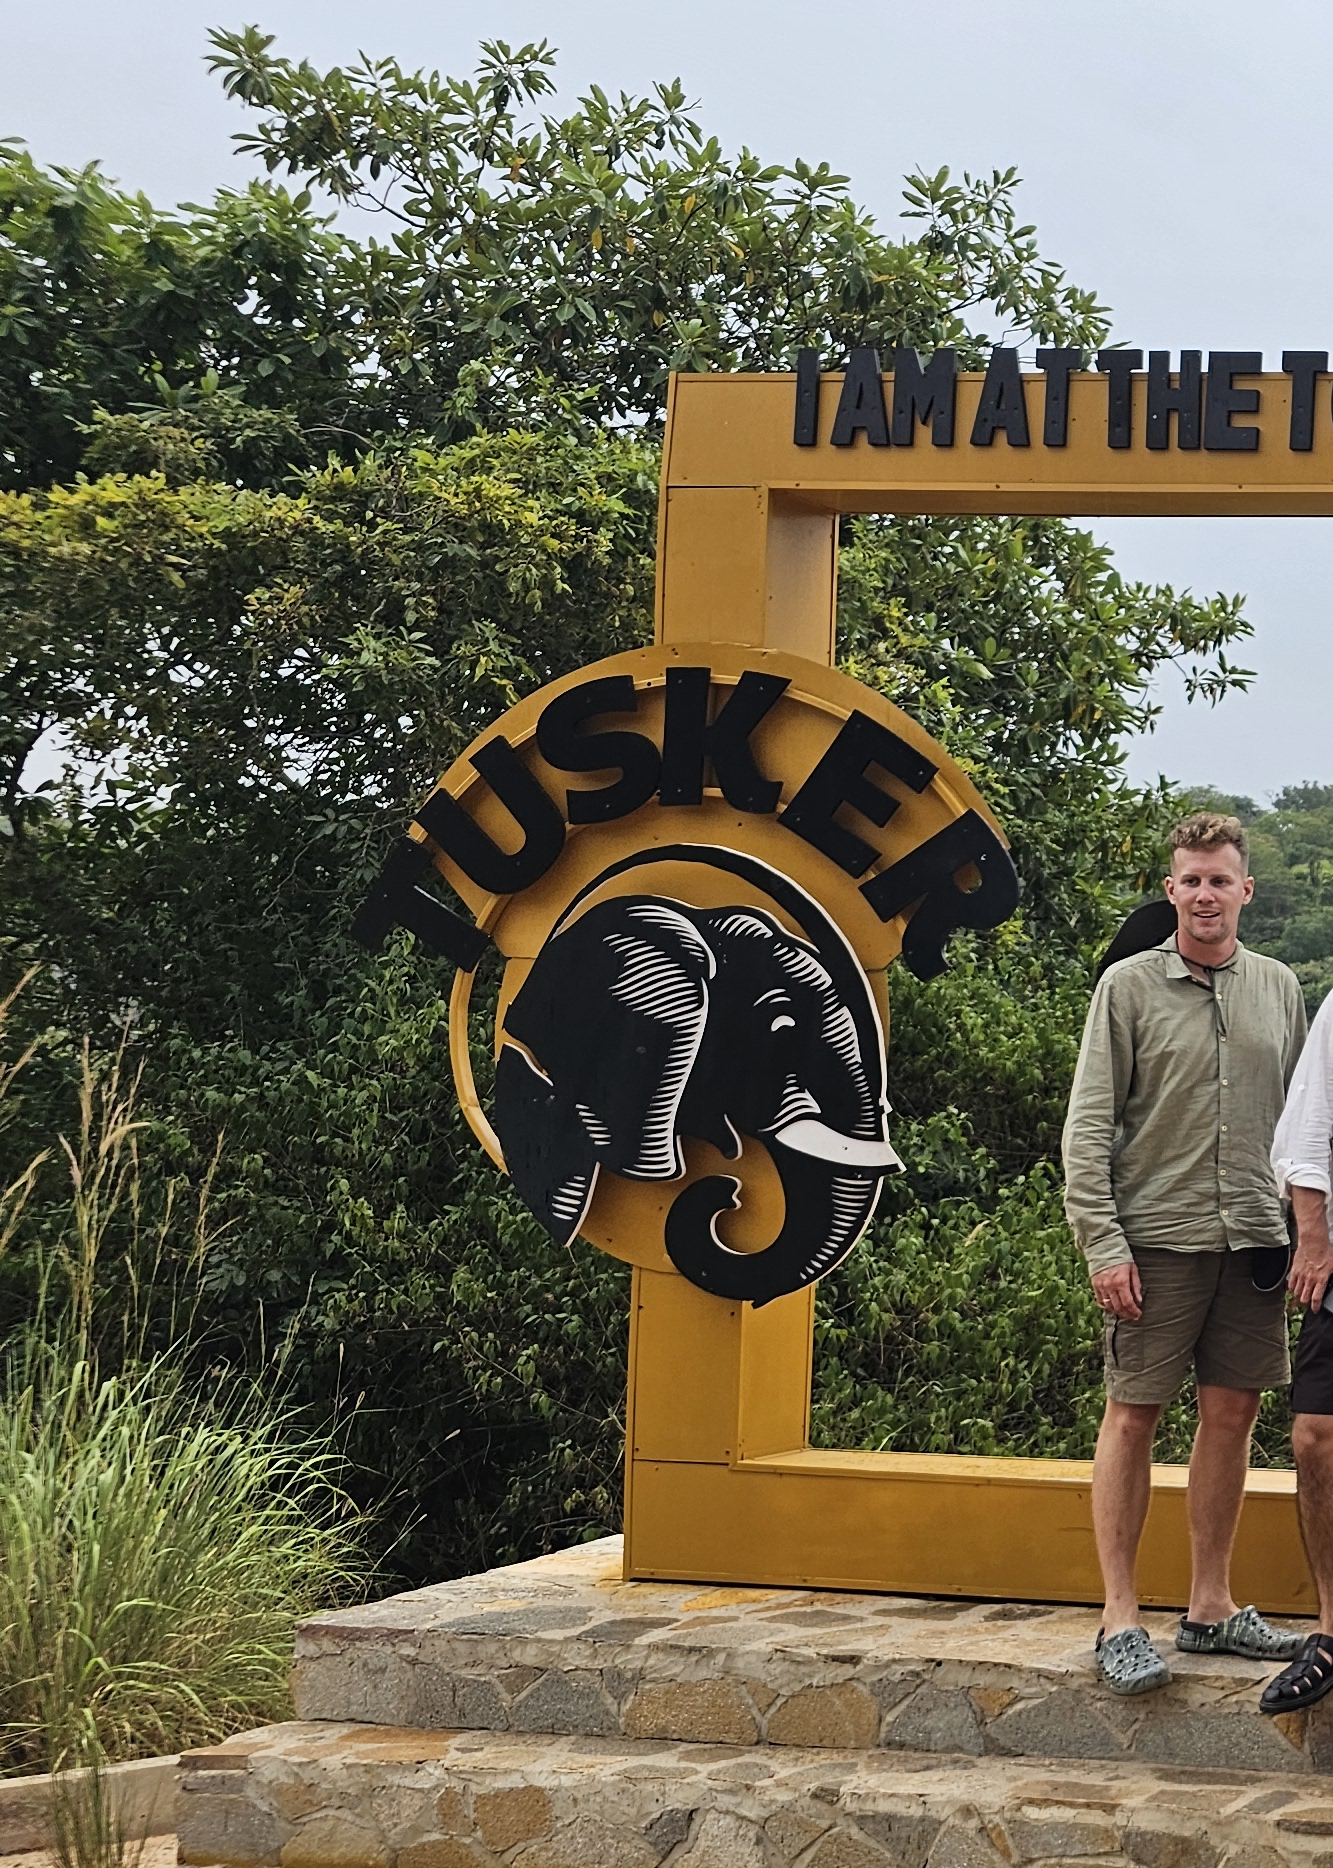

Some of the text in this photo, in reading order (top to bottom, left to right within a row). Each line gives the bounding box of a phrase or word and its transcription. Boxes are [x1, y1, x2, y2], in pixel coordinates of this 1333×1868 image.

[794, 346, 820, 447] I
[829, 346, 956, 447] AM
[969, 347, 1081, 447] AT
[1097, 348, 1263, 452] THE
[350, 666, 1020, 982] TUSKER
